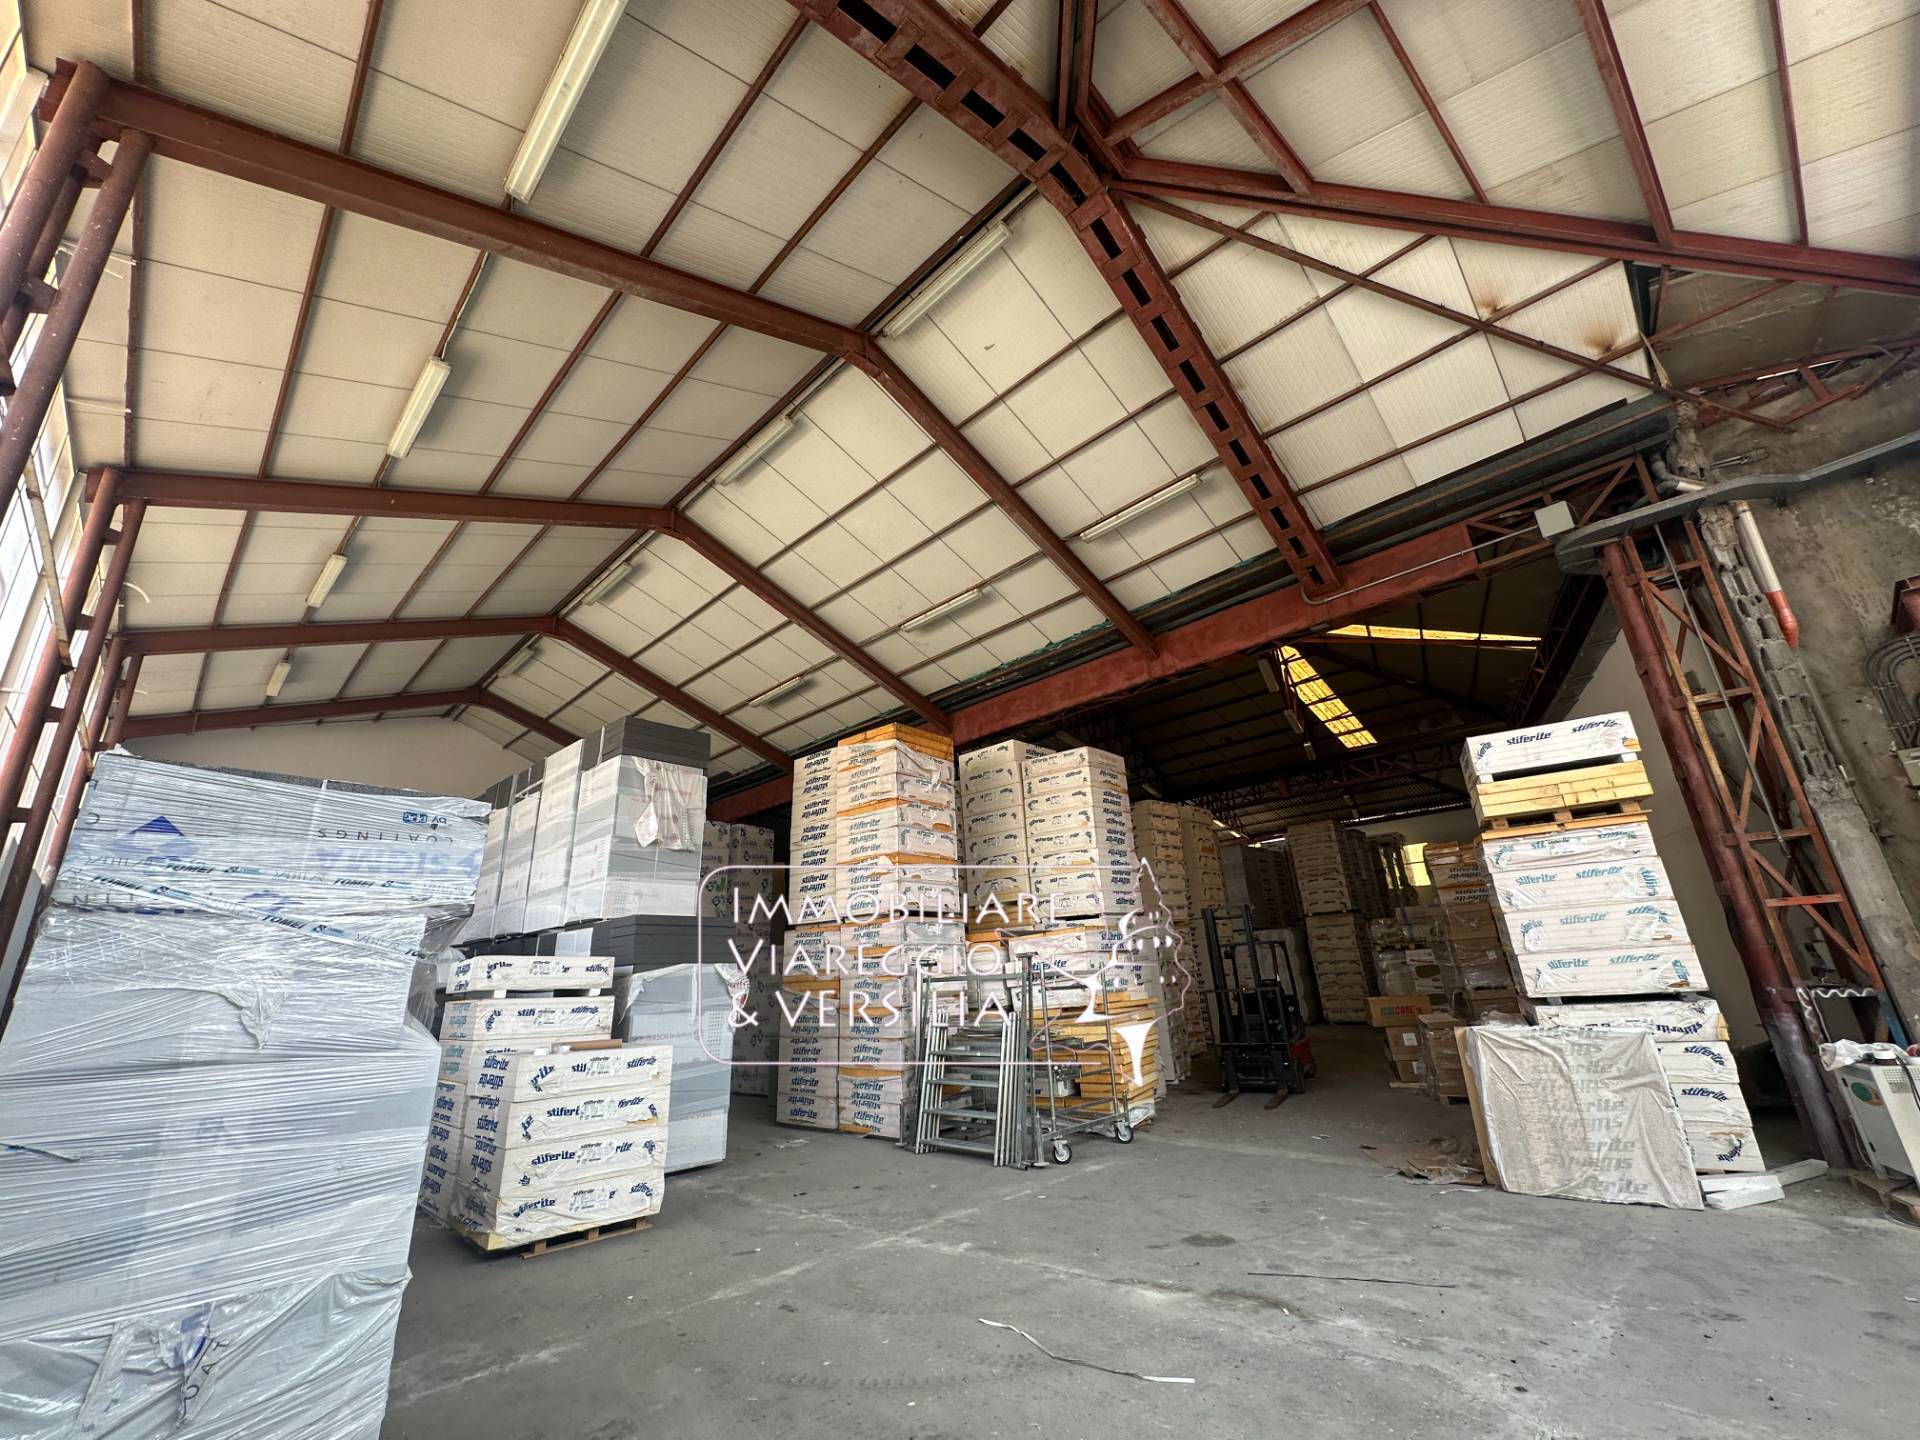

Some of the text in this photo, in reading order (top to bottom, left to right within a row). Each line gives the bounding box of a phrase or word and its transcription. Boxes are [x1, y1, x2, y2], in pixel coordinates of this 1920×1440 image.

[1506, 731, 1552, 745] stiferite
[804, 799, 831, 810] stiferite
[432, 816, 447, 825] by
[849, 819, 881, 831] stiferite
[166, 863, 216, 874] TOMEI
[1575, 865, 1625, 879] stiferite
[333, 878, 374, 887] TOMEI
[802, 873, 829, 884] stiferite
[1515, 873, 1557, 886] stiferite
[262, 914, 305, 930] TOMEI
[1559, 911, 1608, 925] stiferite
[1547, 958, 1589, 970] stiferite
[1608, 952, 1662, 966] stiferite
[792, 1046, 820, 1055] stiferite
[1683, 1045, 1725, 1067] stiferite
[483, 1054, 511, 1071] stiferite
[478, 1073, 505, 1090] stiferite
[617, 1095, 646, 1109] ferite
[1681, 1087, 1728, 1103] stiferite
[546, 1105, 580, 1118] stiferi
[476, 1115, 499, 1133] stiferite
[531, 1150, 576, 1166] stiferite
